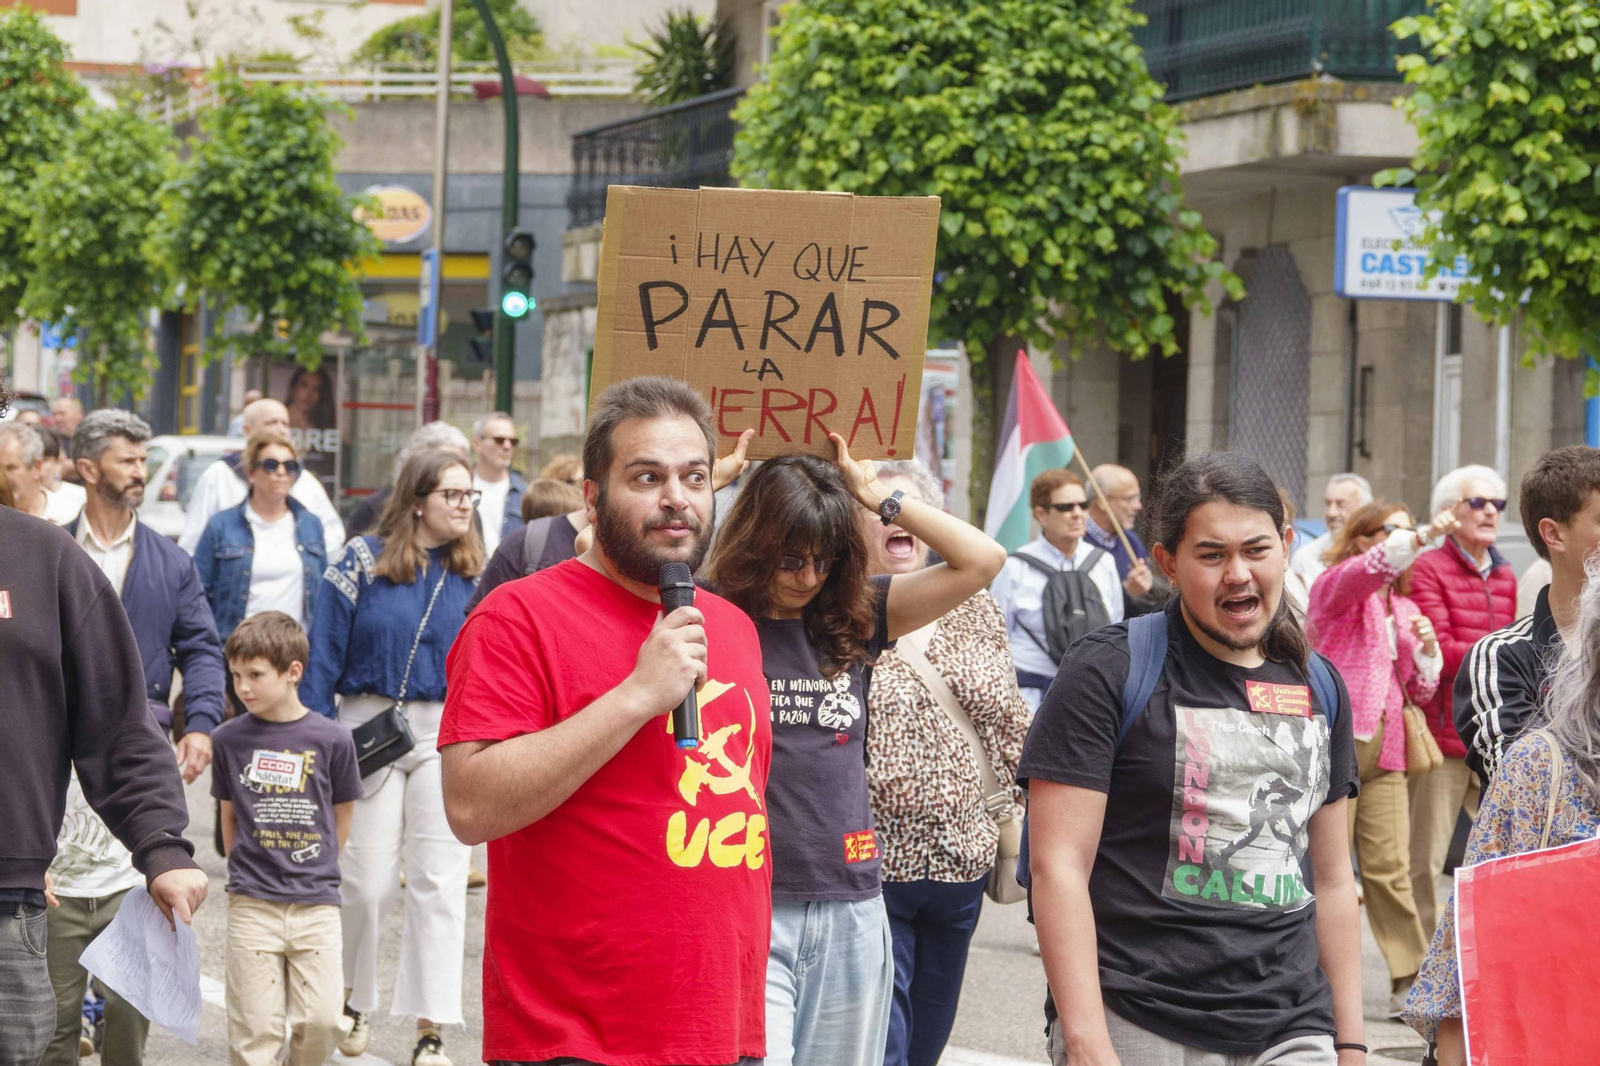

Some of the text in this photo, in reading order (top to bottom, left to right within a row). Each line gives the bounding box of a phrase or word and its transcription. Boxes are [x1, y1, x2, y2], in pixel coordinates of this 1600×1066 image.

[697, 232, 775, 278] HAY
[794, 242, 869, 282] QUE
[638, 280, 901, 360] PARAR
[742, 358, 784, 381] LA
[771, 679, 832, 692] EN MINORÍA
[1273, 685, 1308, 696] Unificación
[794, 695, 814, 708] QUE
[1276, 695, 1312, 708] Comunista
[1278, 704, 1303, 714] España
[779, 709, 812, 725] RAZÓN
[1210, 721, 1270, 737] The Clash
[259, 760, 295, 773] CCOO
[1179, 711, 1211, 863] LONDON
[666, 810, 766, 870] UCE
[1173, 864, 1305, 906] CALLING
